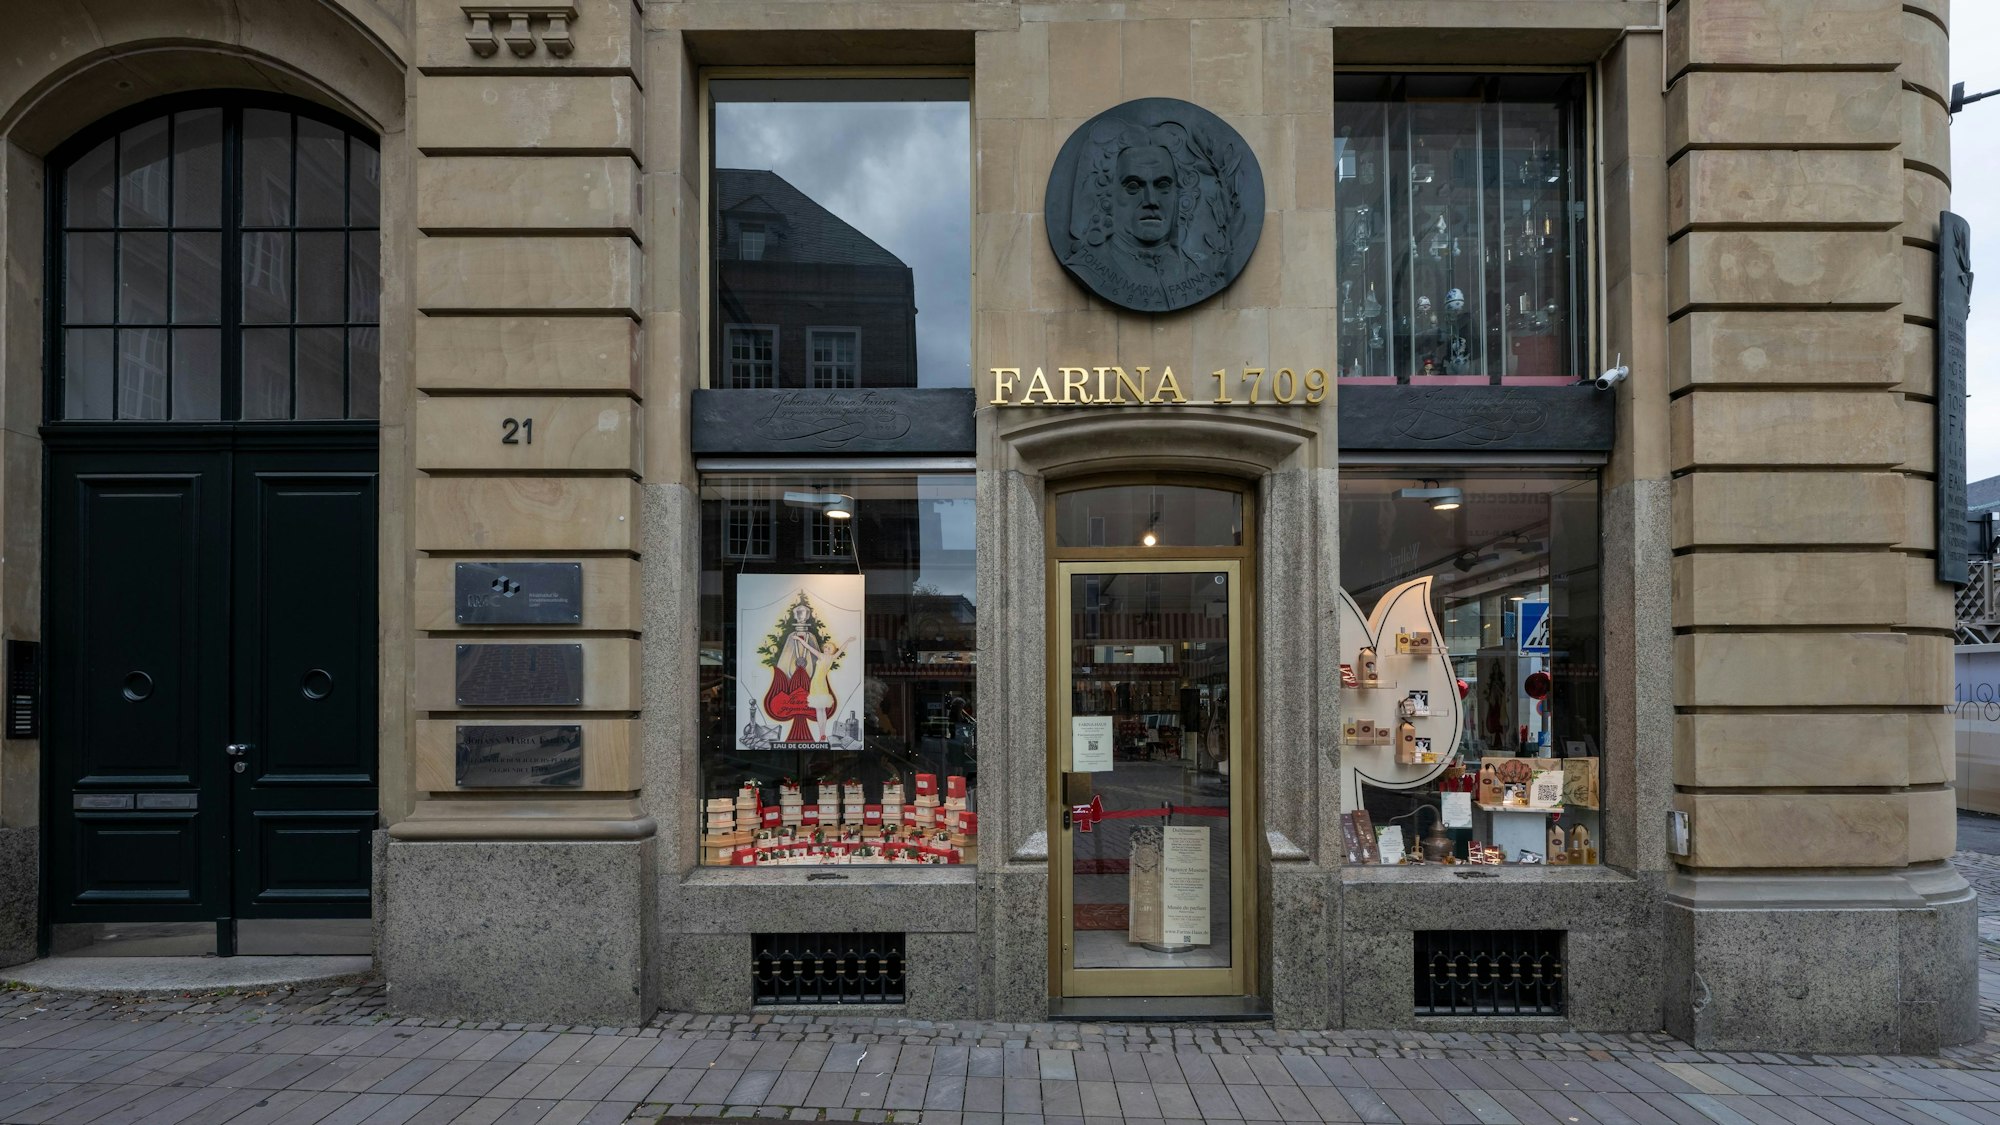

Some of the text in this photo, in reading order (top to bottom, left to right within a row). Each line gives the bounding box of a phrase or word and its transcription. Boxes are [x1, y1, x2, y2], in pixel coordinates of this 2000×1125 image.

[1083, 249, 1210, 297] JOHANN MARIA FARINA
[990, 365, 1330, 405] FARINA 1709
[821, 392, 858, 407] Maria
[857, 391, 897, 407] Farina
[502, 418, 532, 444] 21
[505, 736, 536, 745] MARIA
